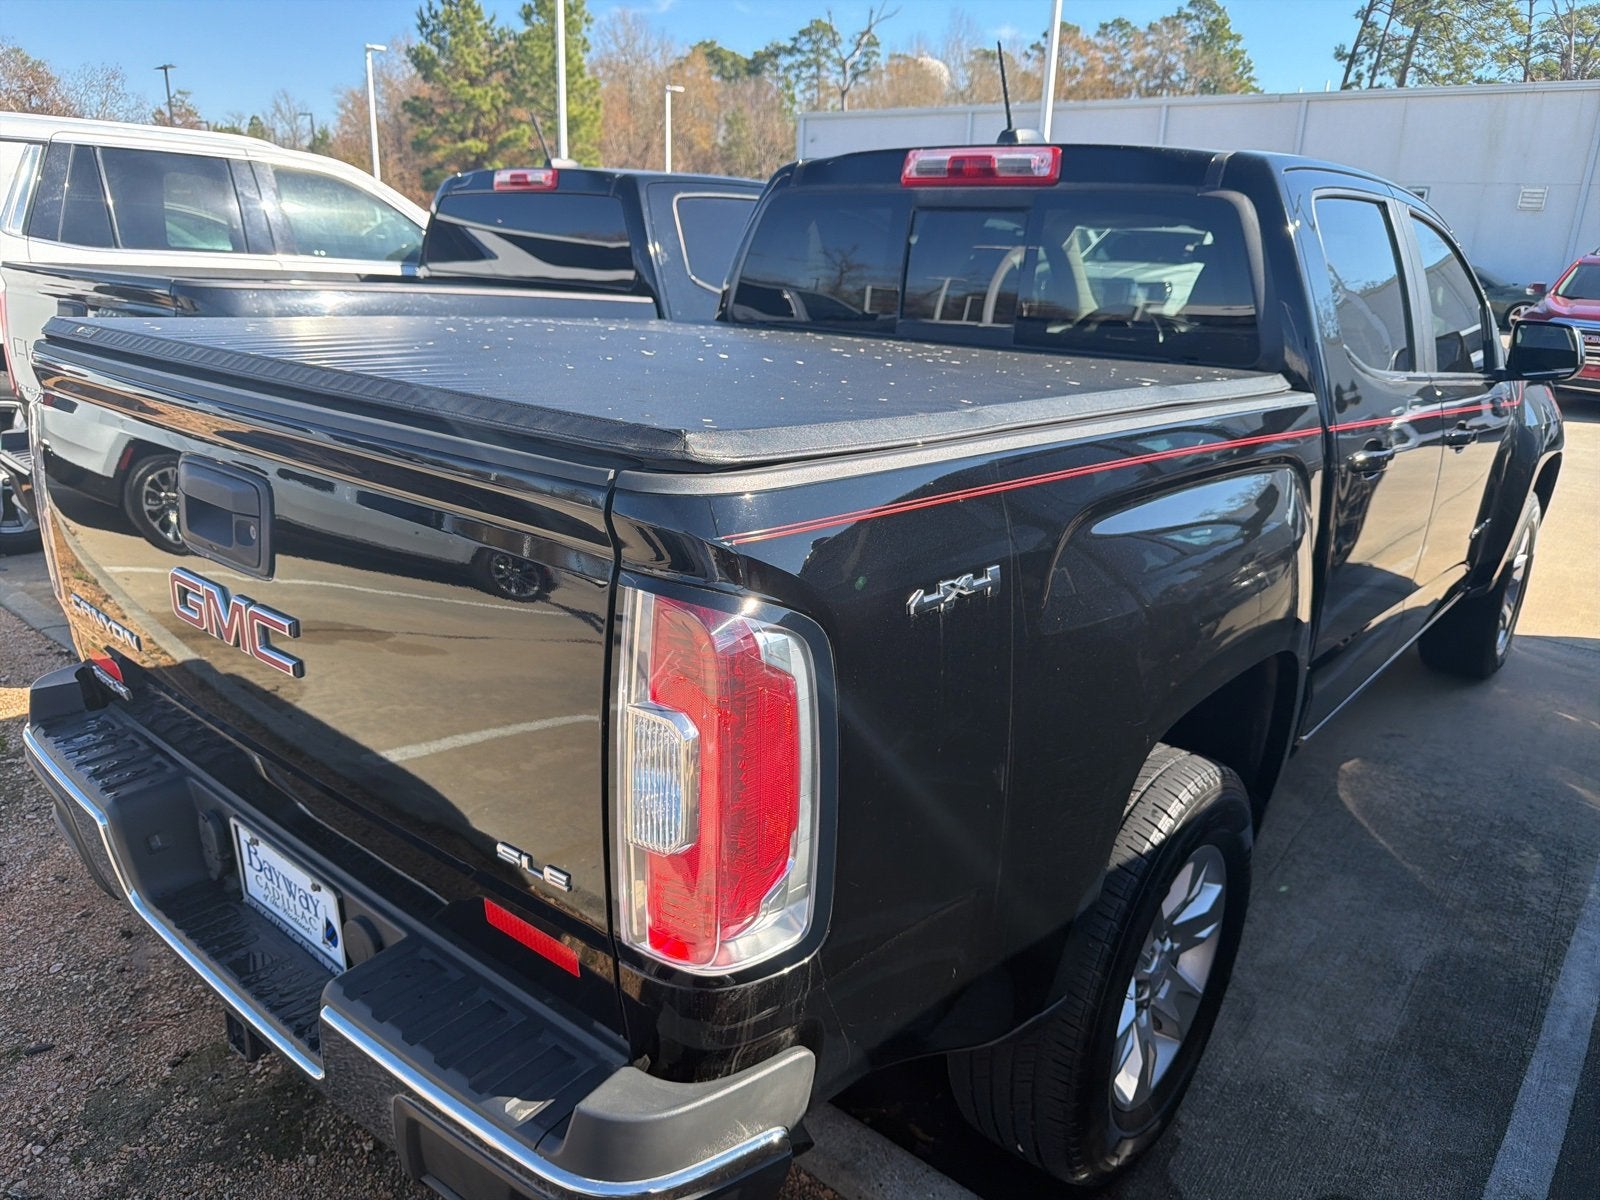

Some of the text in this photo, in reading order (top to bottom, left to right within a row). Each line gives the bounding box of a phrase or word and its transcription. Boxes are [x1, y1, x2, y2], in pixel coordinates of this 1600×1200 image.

[70, 593, 142, 651] CANYON
[169, 567, 305, 678] GMC
[496, 842, 572, 892] SLE
[255, 875, 318, 930] CADILLAC
